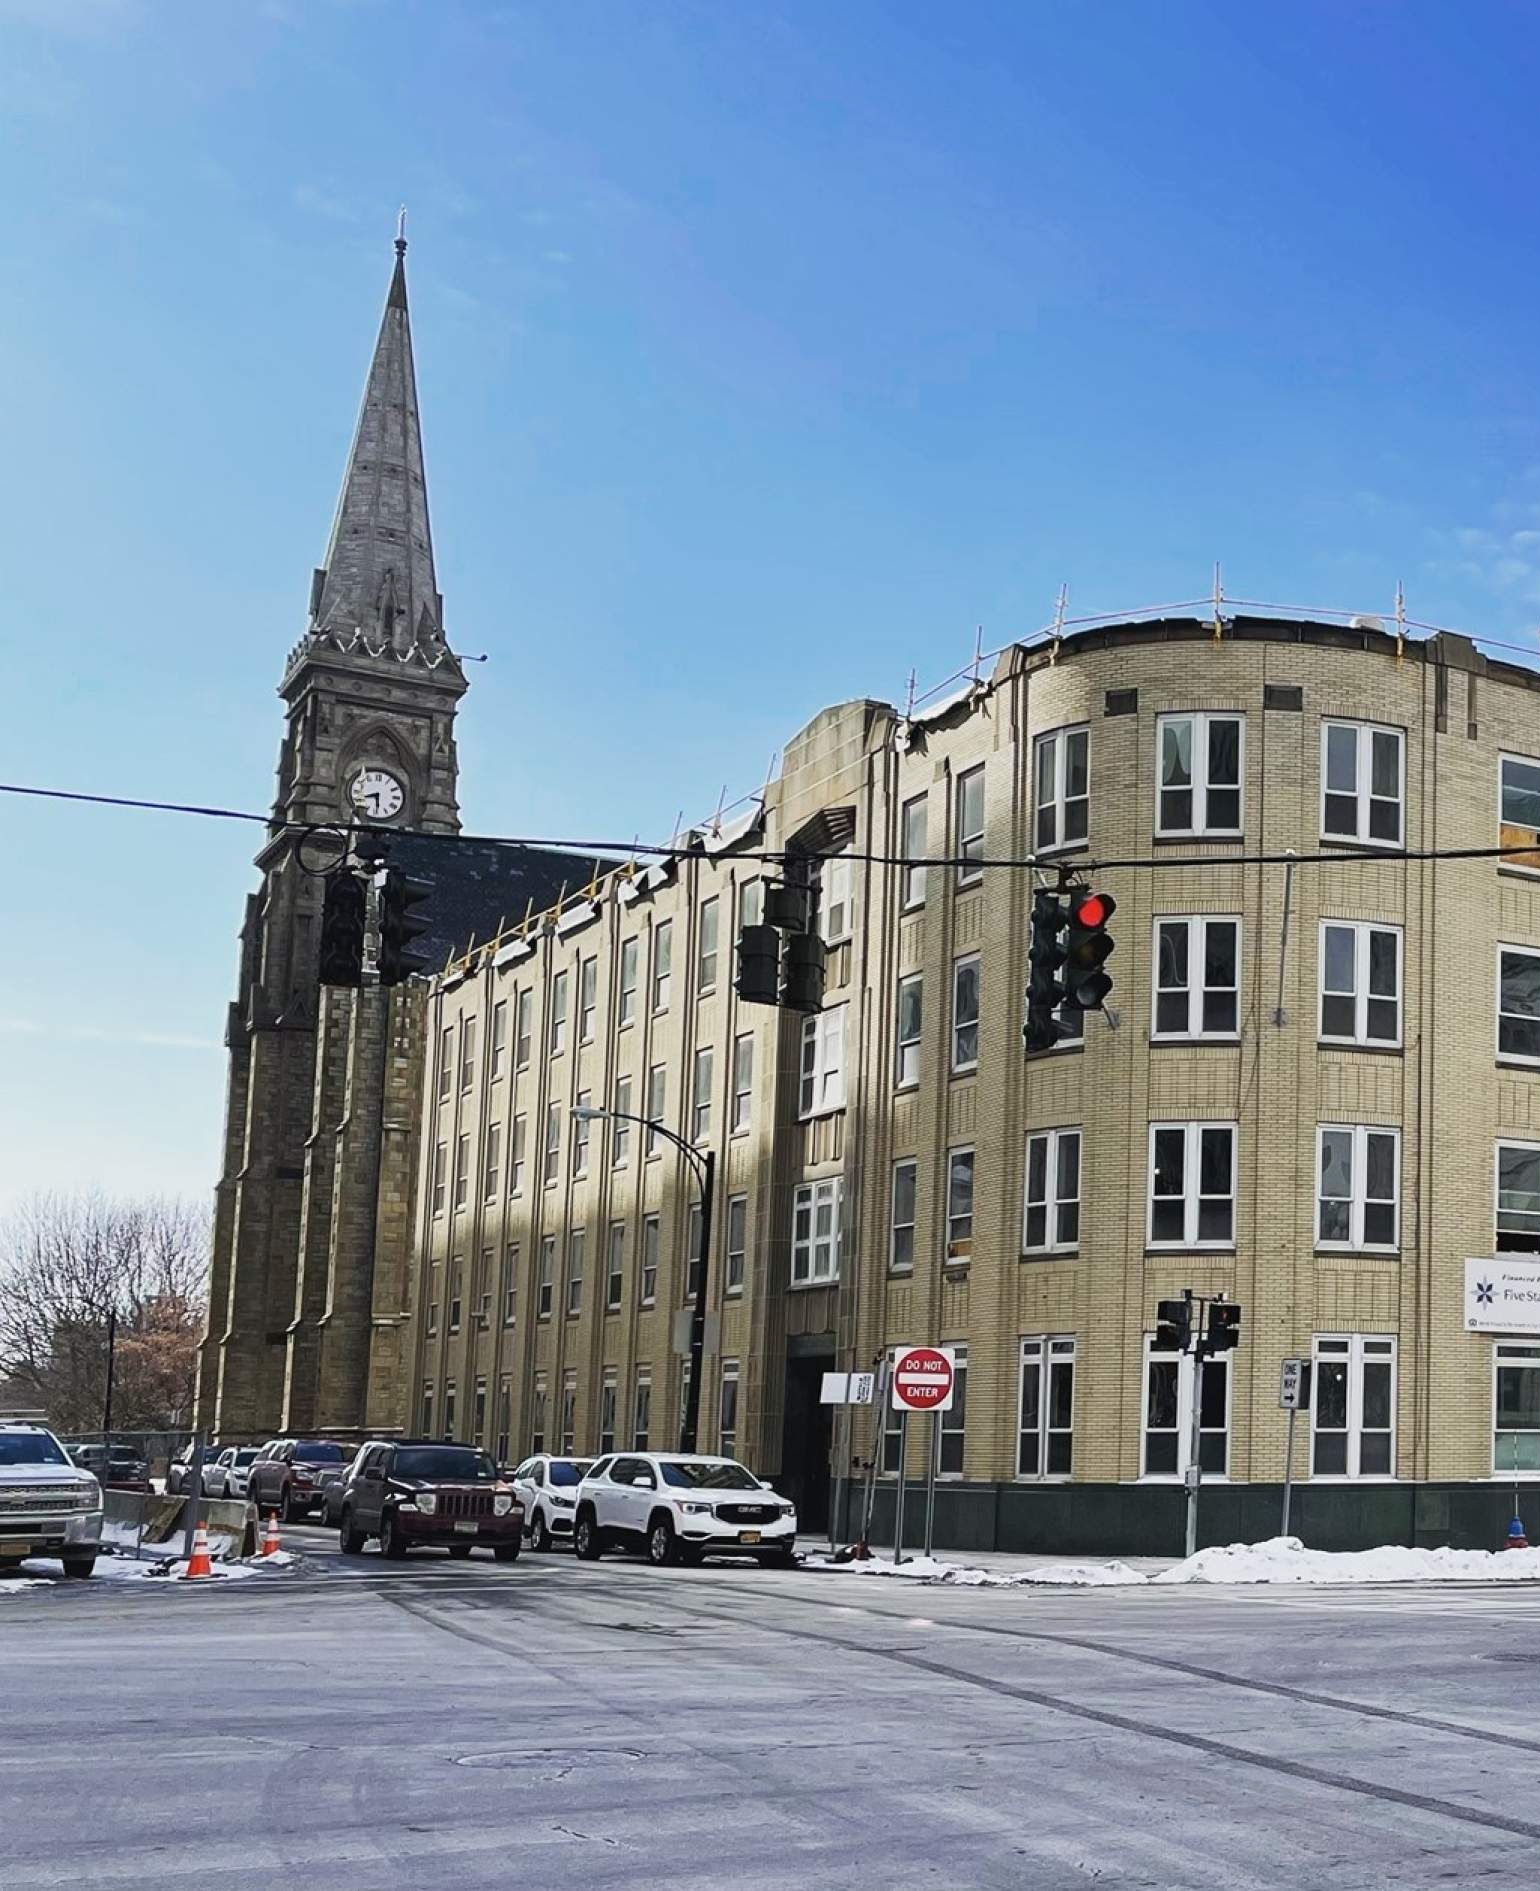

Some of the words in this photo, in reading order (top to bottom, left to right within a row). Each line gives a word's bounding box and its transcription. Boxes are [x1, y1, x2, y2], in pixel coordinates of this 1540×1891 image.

[1503, 1289, 1526, 1302] Five
[906, 1360, 920, 1370] DO
[923, 1360, 943, 1371] NOT
[1284, 1363, 1297, 1376] ONE
[1284, 1379, 1297, 1389] WAY
[906, 1386, 939, 1398] ENTER
[737, 1505, 763, 1513] GMC
